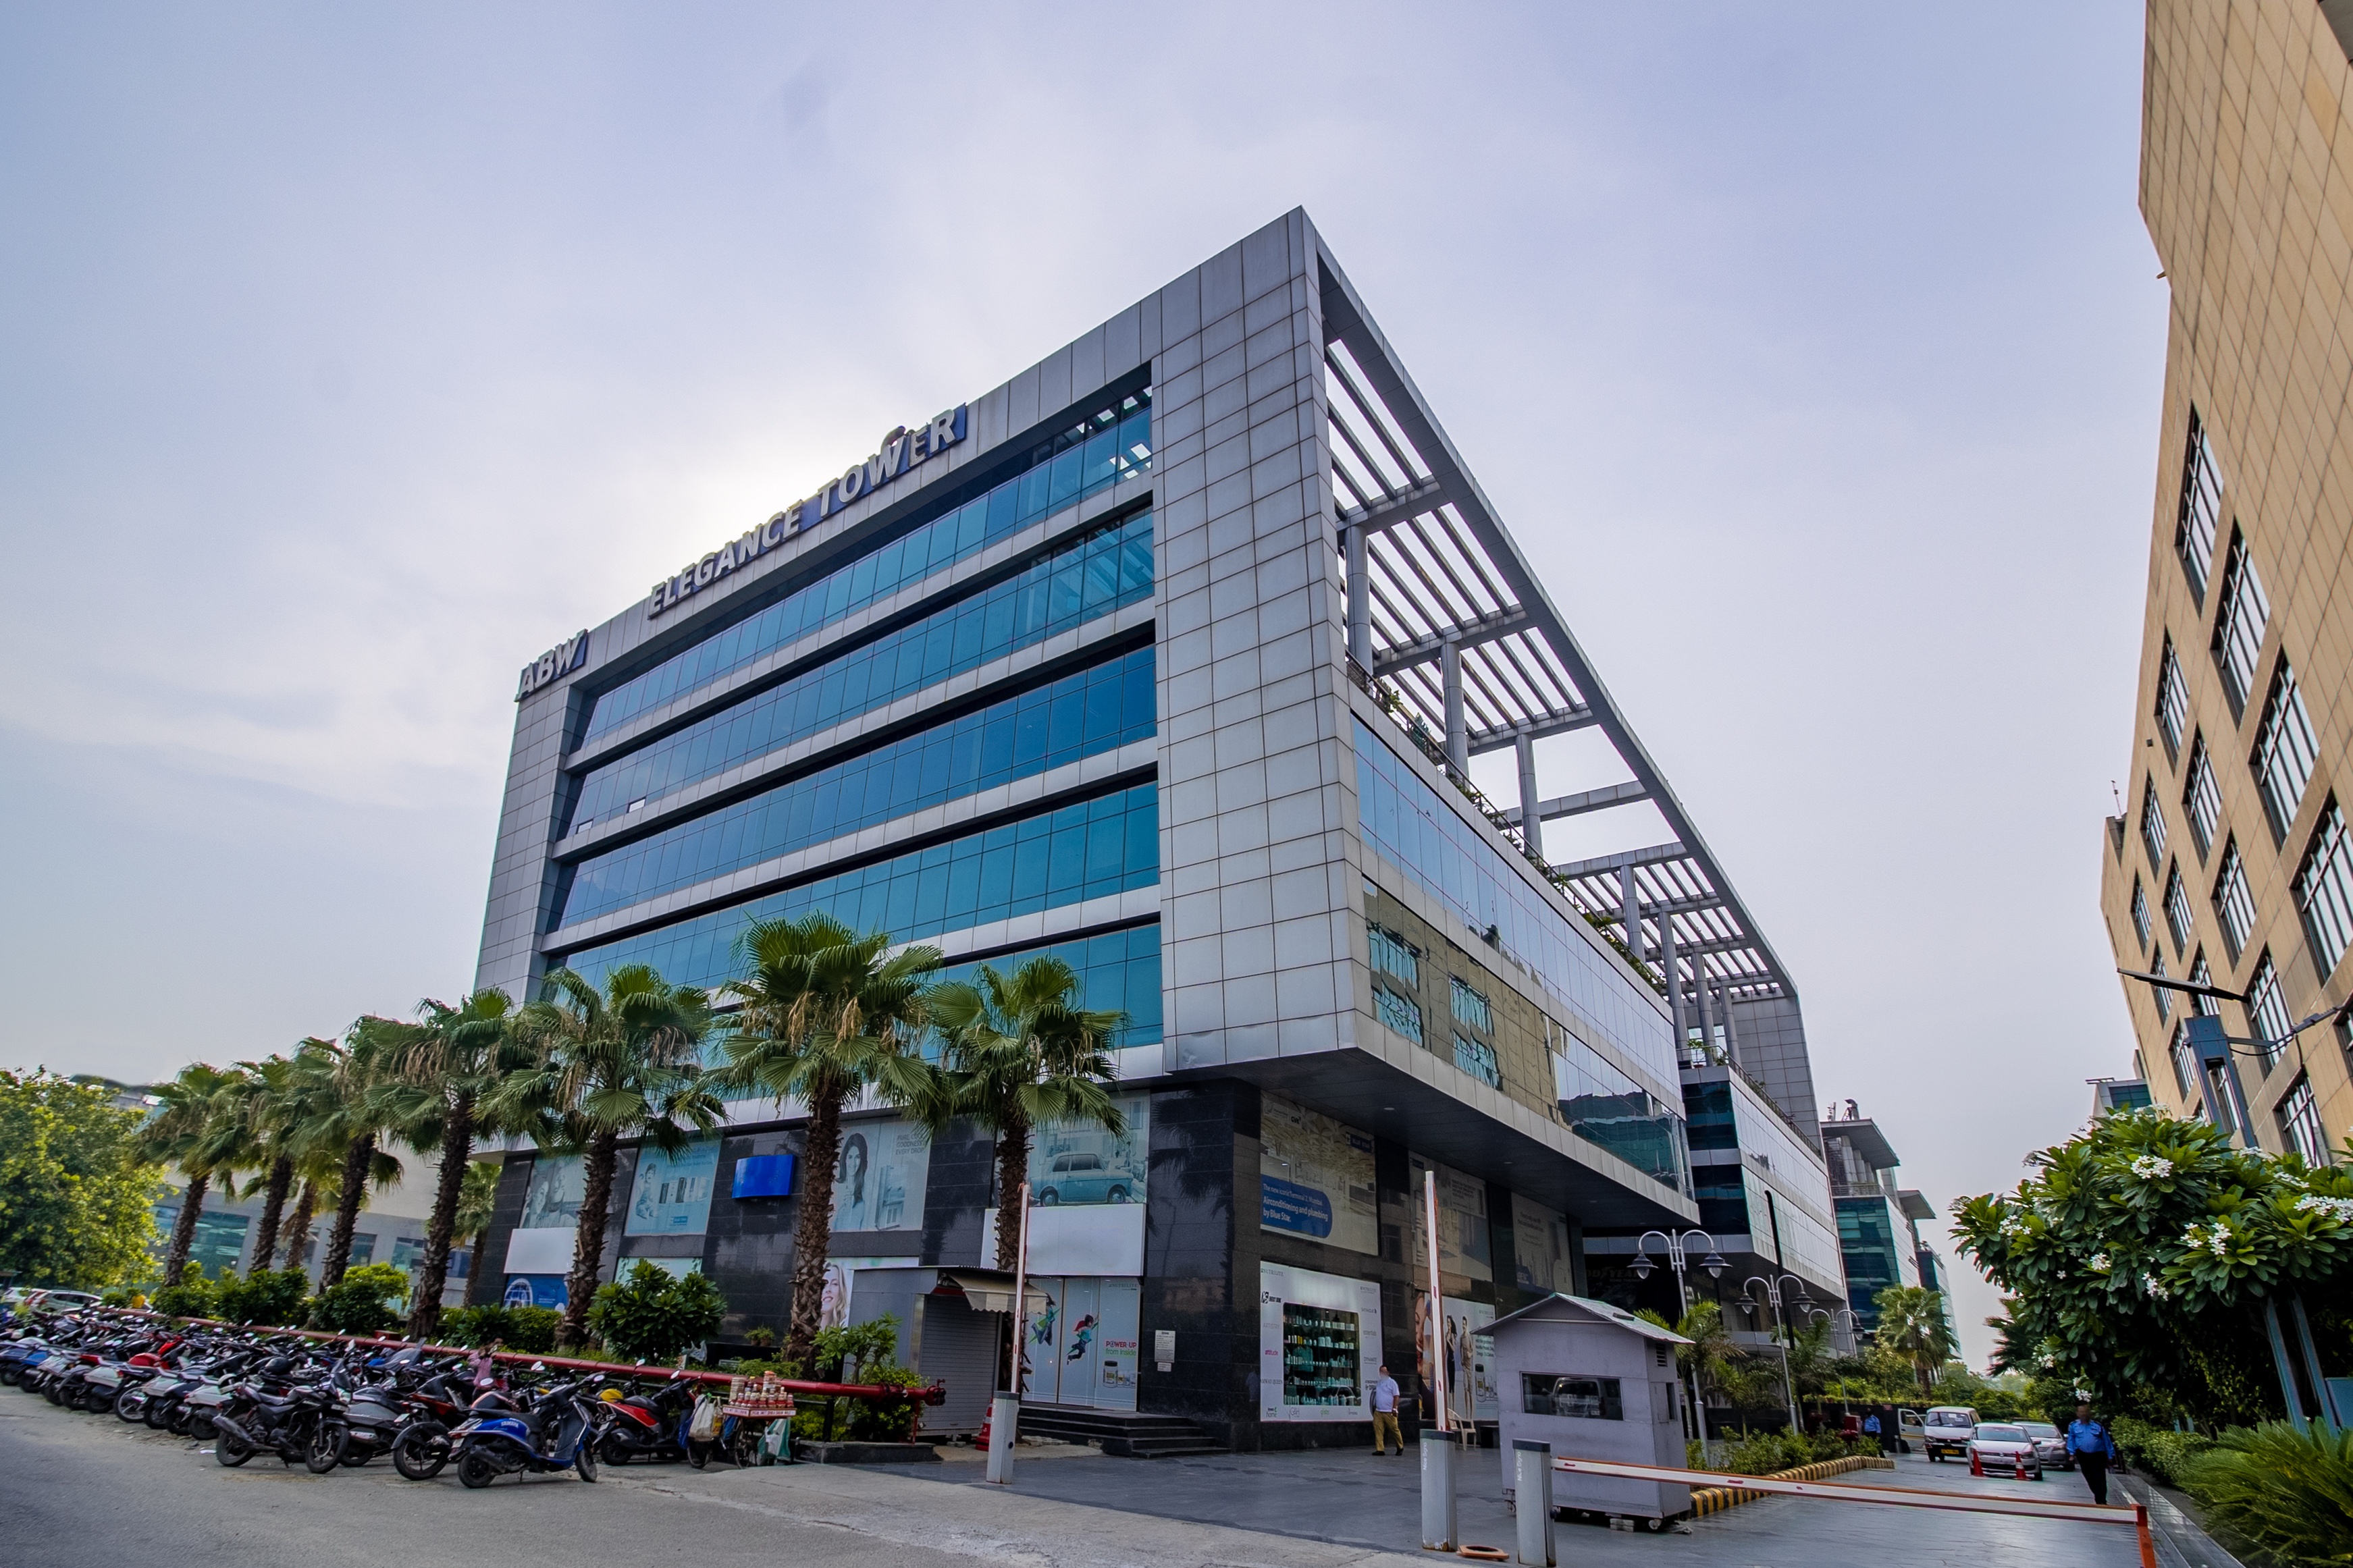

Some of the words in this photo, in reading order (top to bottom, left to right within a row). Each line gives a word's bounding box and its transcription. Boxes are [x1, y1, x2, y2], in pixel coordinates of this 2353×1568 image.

[517, 629, 587, 699] ABW
[649, 500, 803, 619] ELEGANCE
[818, 409, 956, 518] TOWER
[1263, 1196, 1298, 1214] Airconditioning
[1299, 1206, 1307, 1214] and
[1308, 1208, 1328, 1222] plumbing
[1263, 1208, 1269, 1218] by
[1270, 1209, 1281, 1219] Blue
[1281, 1212, 1291, 1222] Star.
